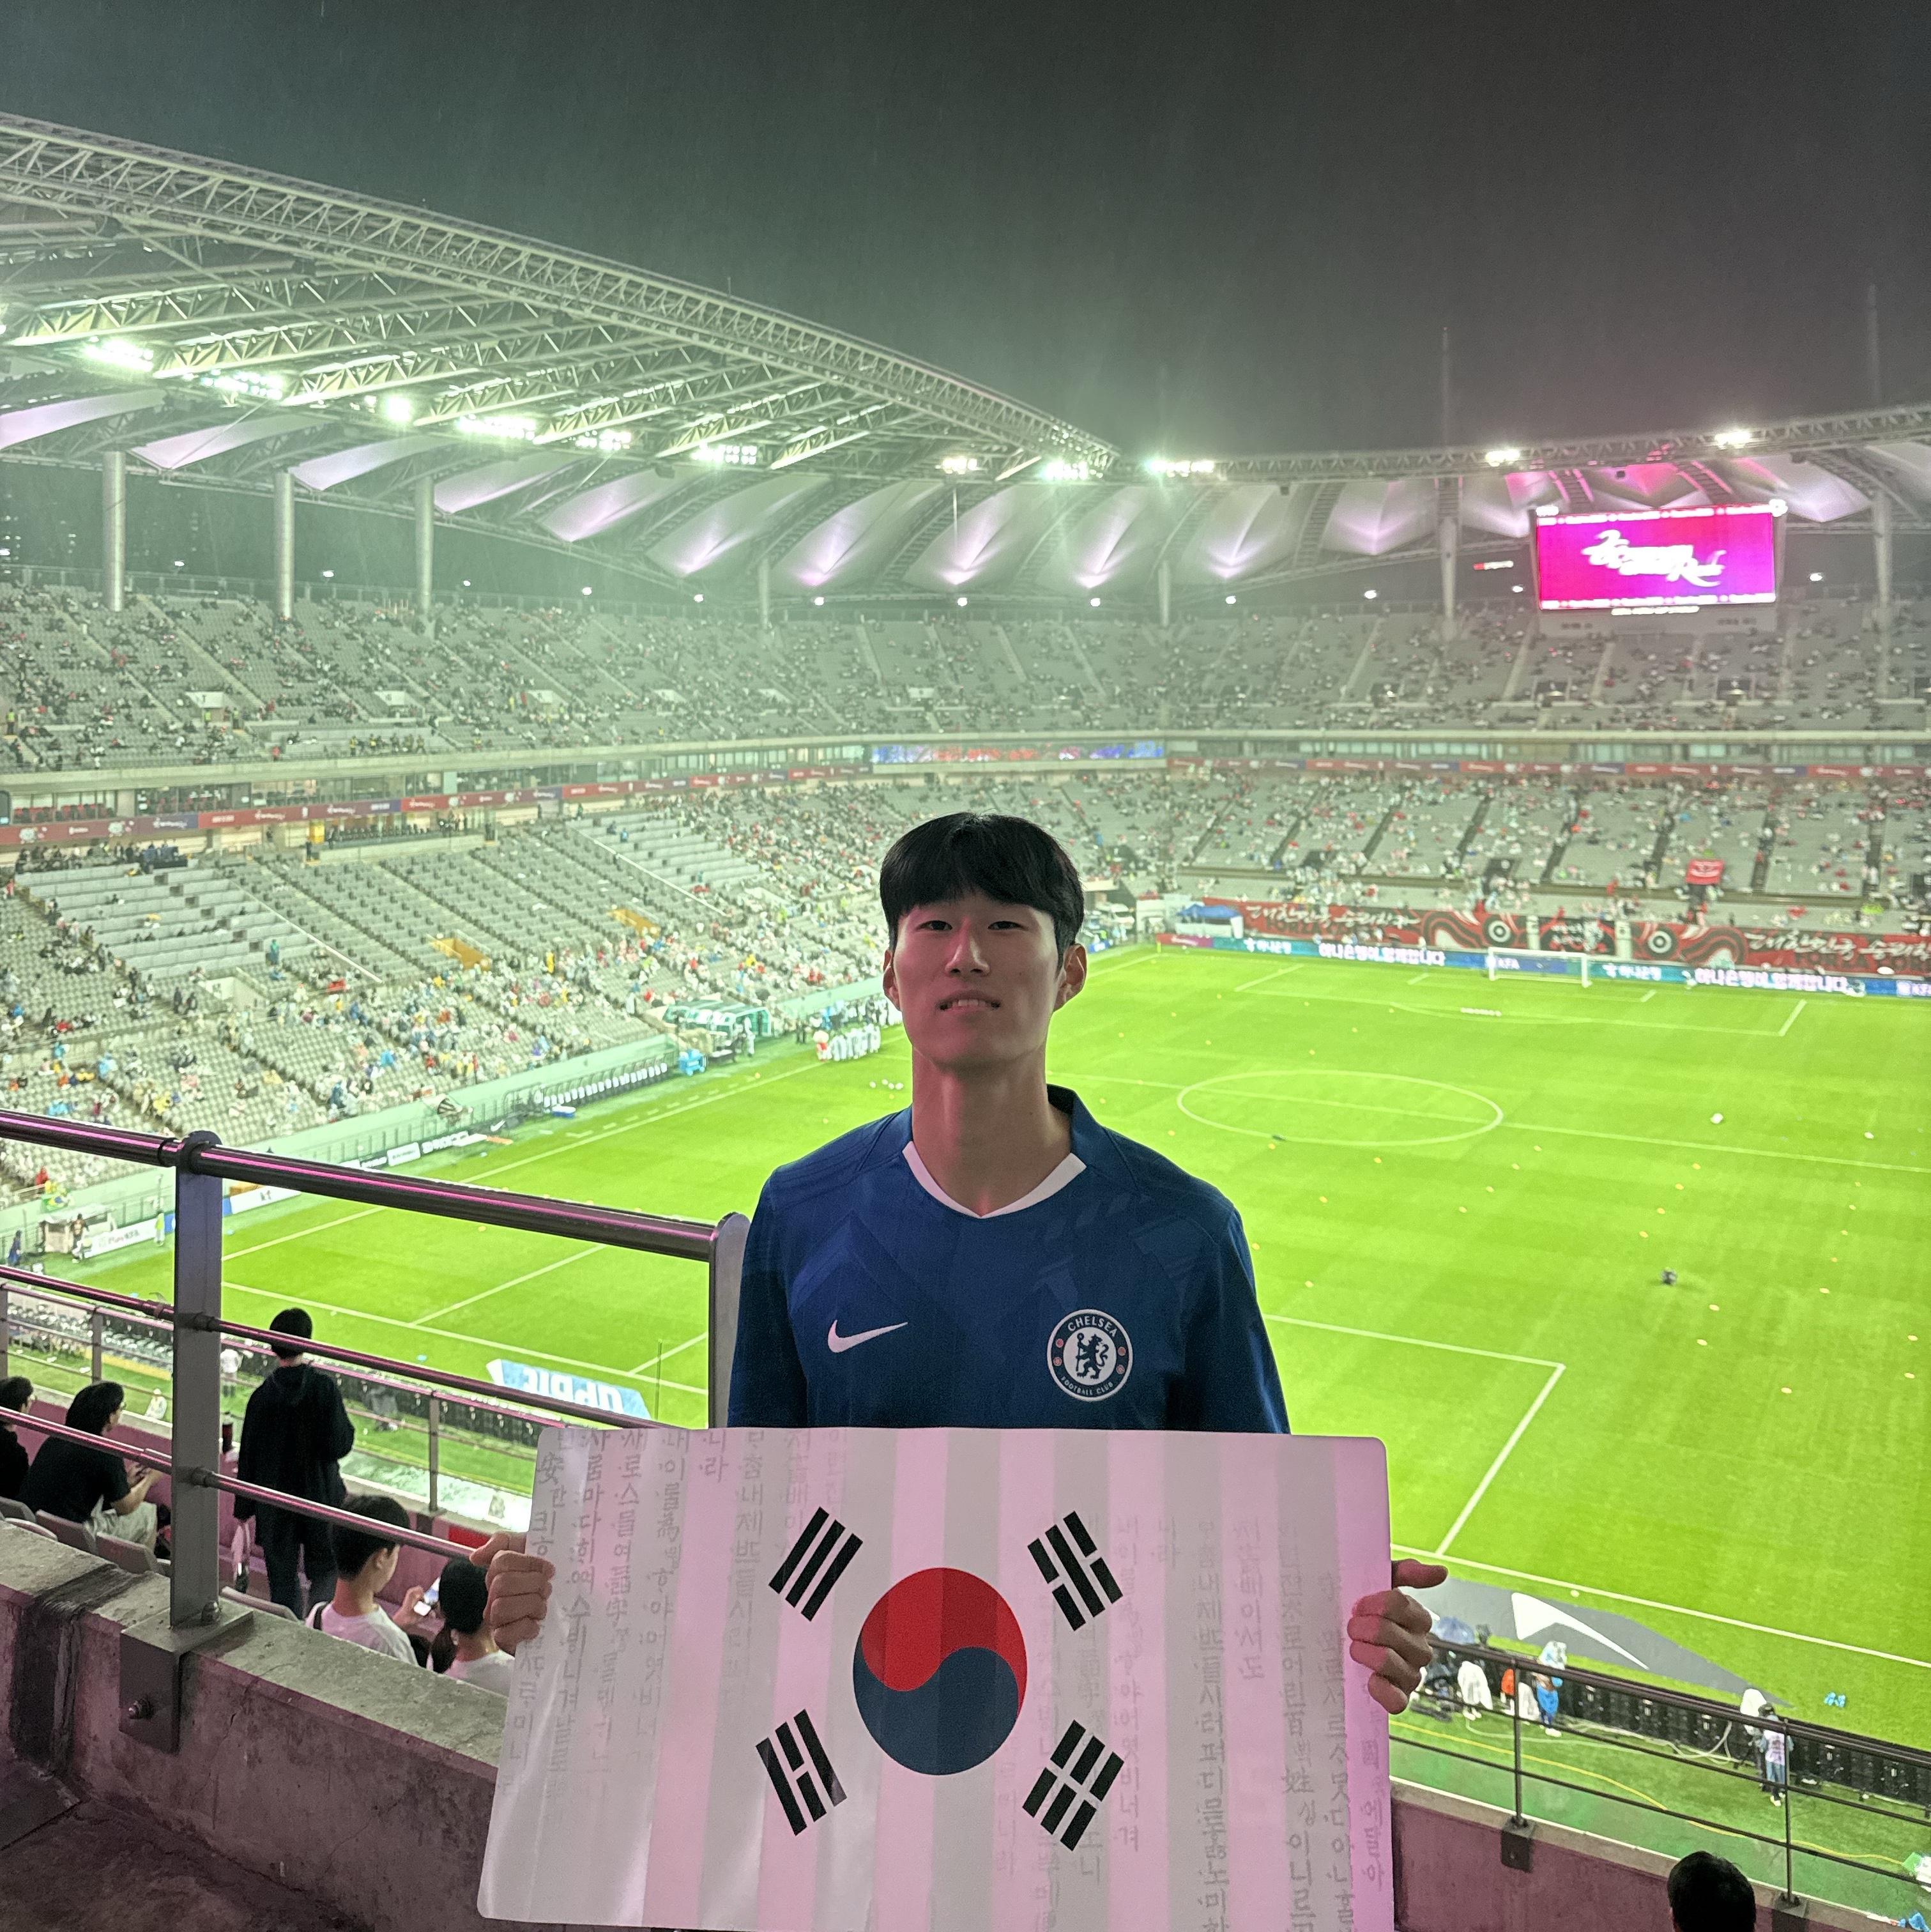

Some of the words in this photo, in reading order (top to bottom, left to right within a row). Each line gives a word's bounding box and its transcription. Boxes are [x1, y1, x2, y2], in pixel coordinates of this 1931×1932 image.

[1067, 1315, 1118, 1338] CHELSEA
[1060, 1375, 1094, 1396] FOOTBALL
[1096, 1381, 1114, 1395] CLUB
